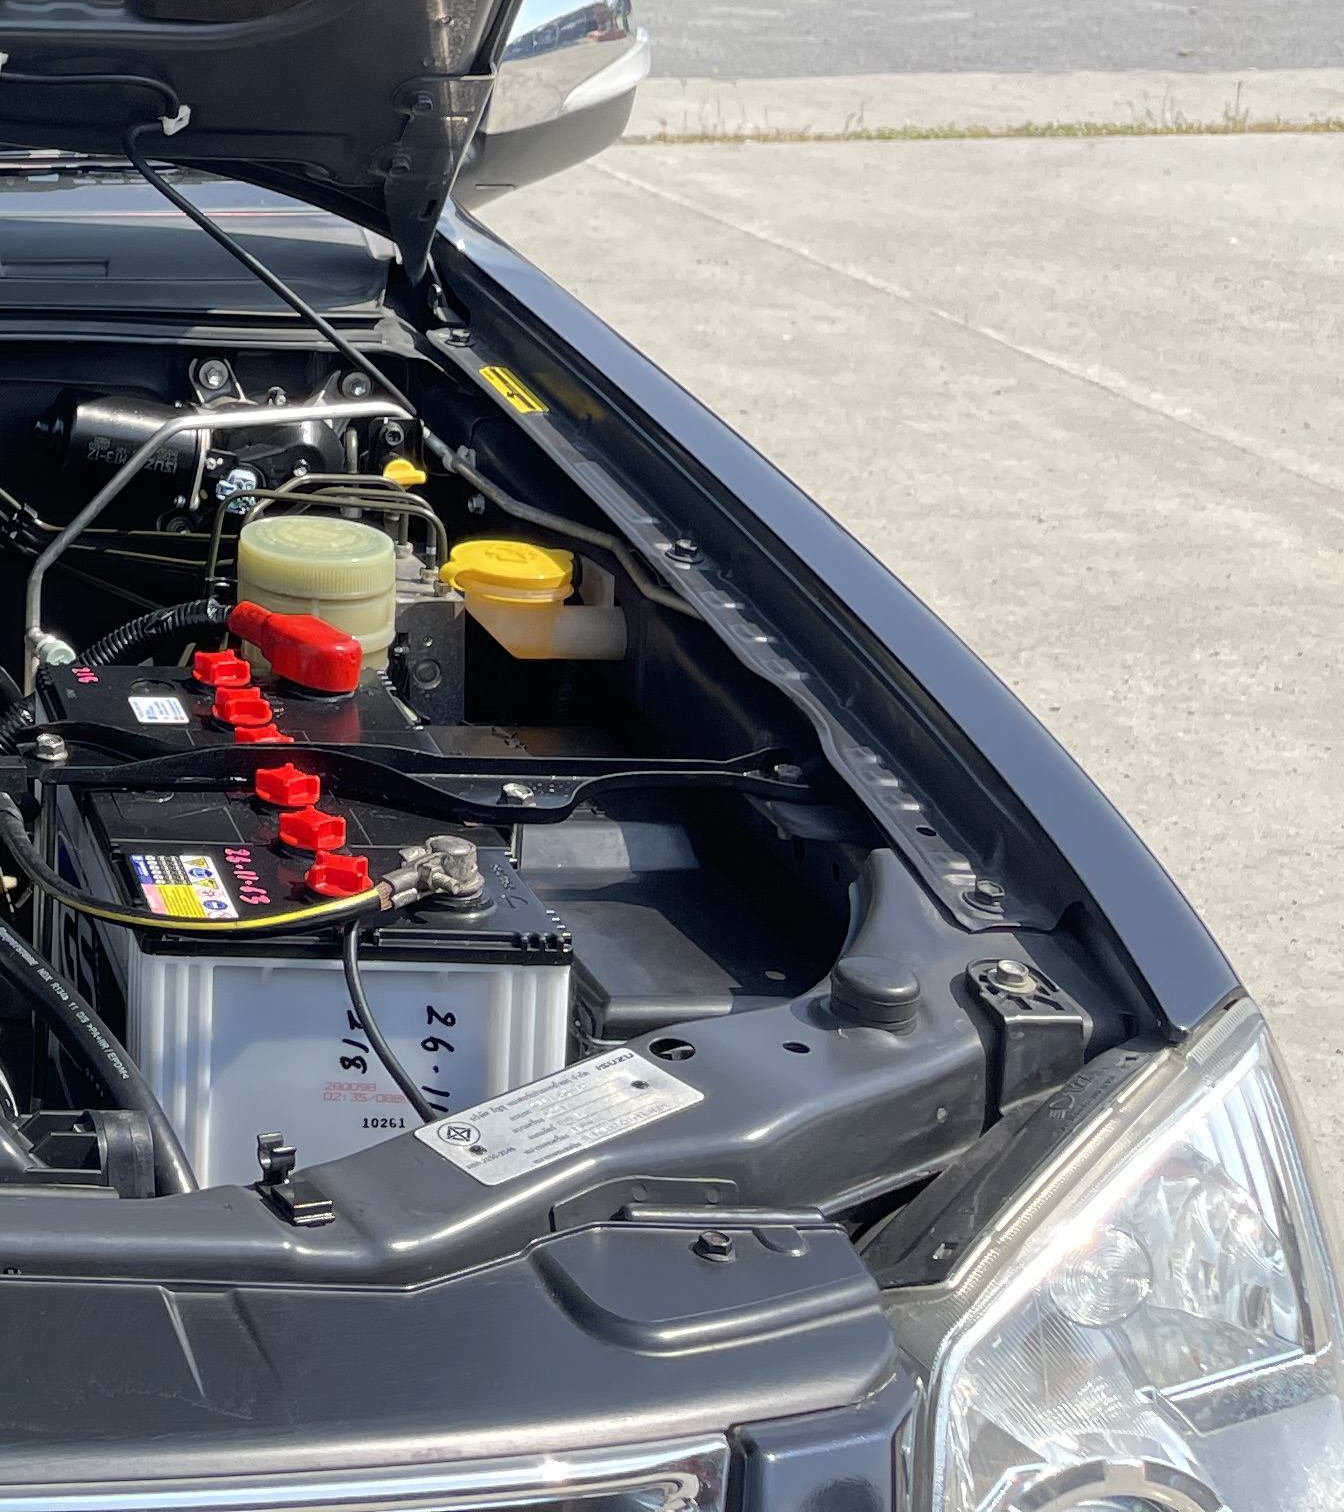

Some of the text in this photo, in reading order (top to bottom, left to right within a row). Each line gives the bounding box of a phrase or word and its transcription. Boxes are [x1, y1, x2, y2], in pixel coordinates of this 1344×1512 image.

[143, 458, 178, 475] ISUZ
[595, 1052, 635, 1071] ISUZU
[362, 1117, 405, 1129] 10261
